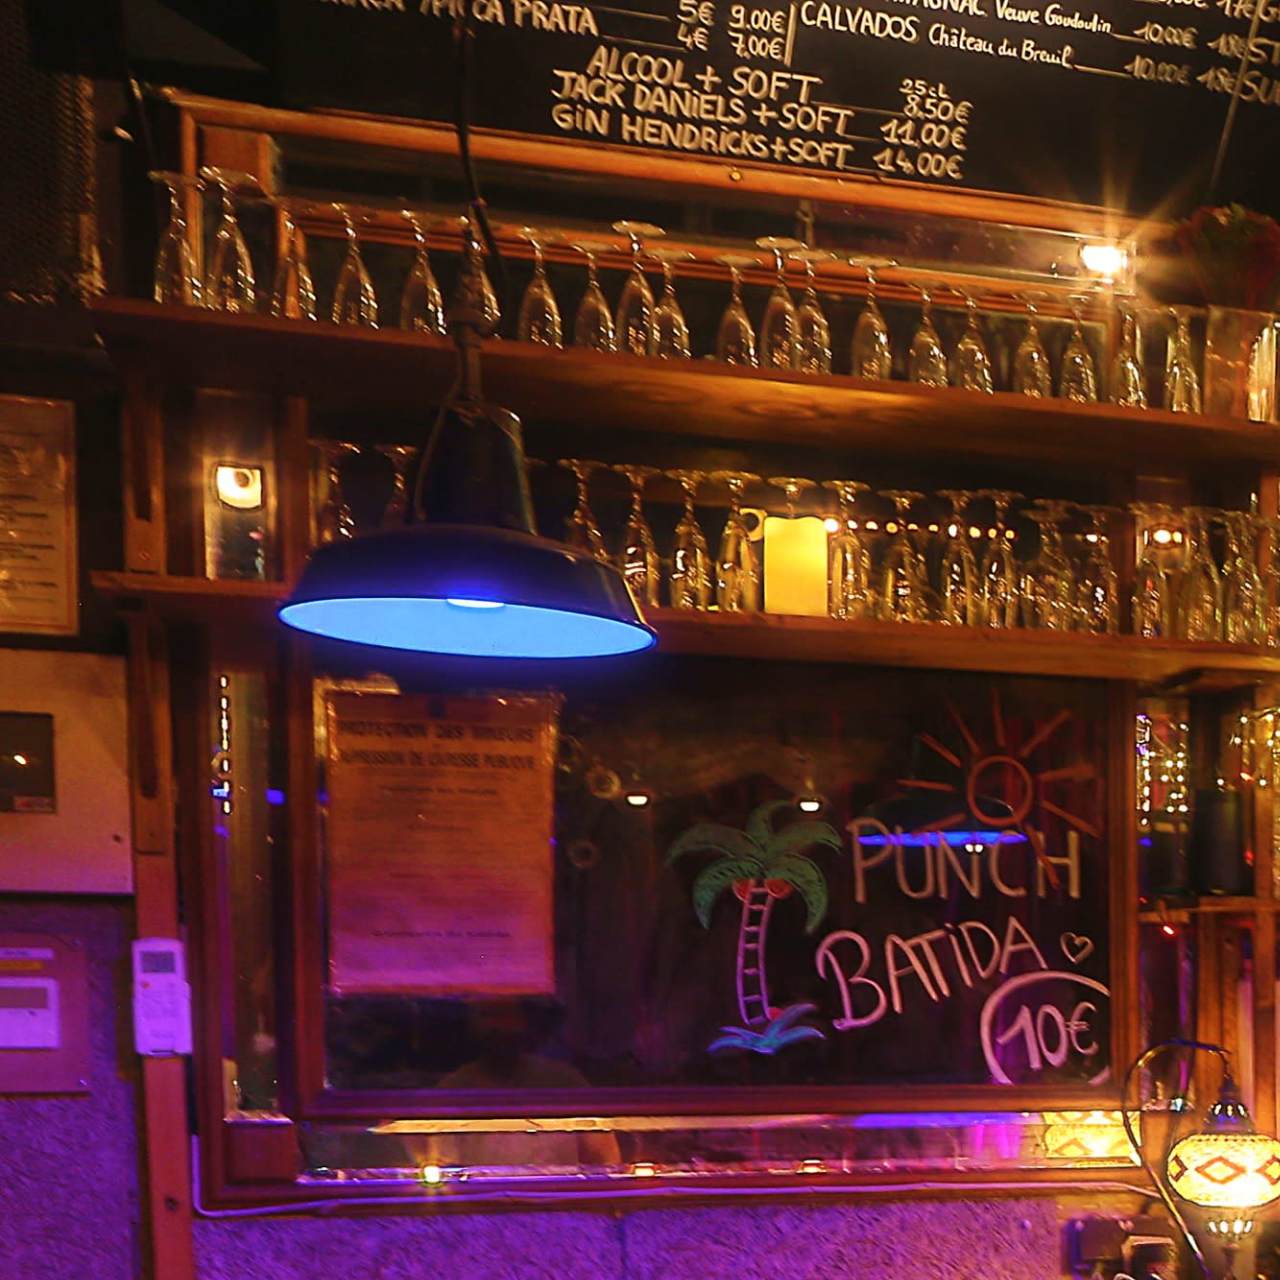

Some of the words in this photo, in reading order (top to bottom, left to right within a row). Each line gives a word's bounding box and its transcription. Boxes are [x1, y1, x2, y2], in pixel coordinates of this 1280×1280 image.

[514, 0, 599, 37] PRATA
[801, 1, 920, 44] CALVADOS
[928, 23, 994, 55] Château
[999, 37, 1018, 58] du
[1021, 39, 1074, 69] Breuil
[996, 0, 1040, 24] Veuve
[552, 69, 626, 109] JACK
[587, 44, 692, 90] ALCOOL
[728, 65, 823, 104] SOFT
[845, 816, 1083, 905] PUNCH
[996, 1000, 1099, 1071] 10€
